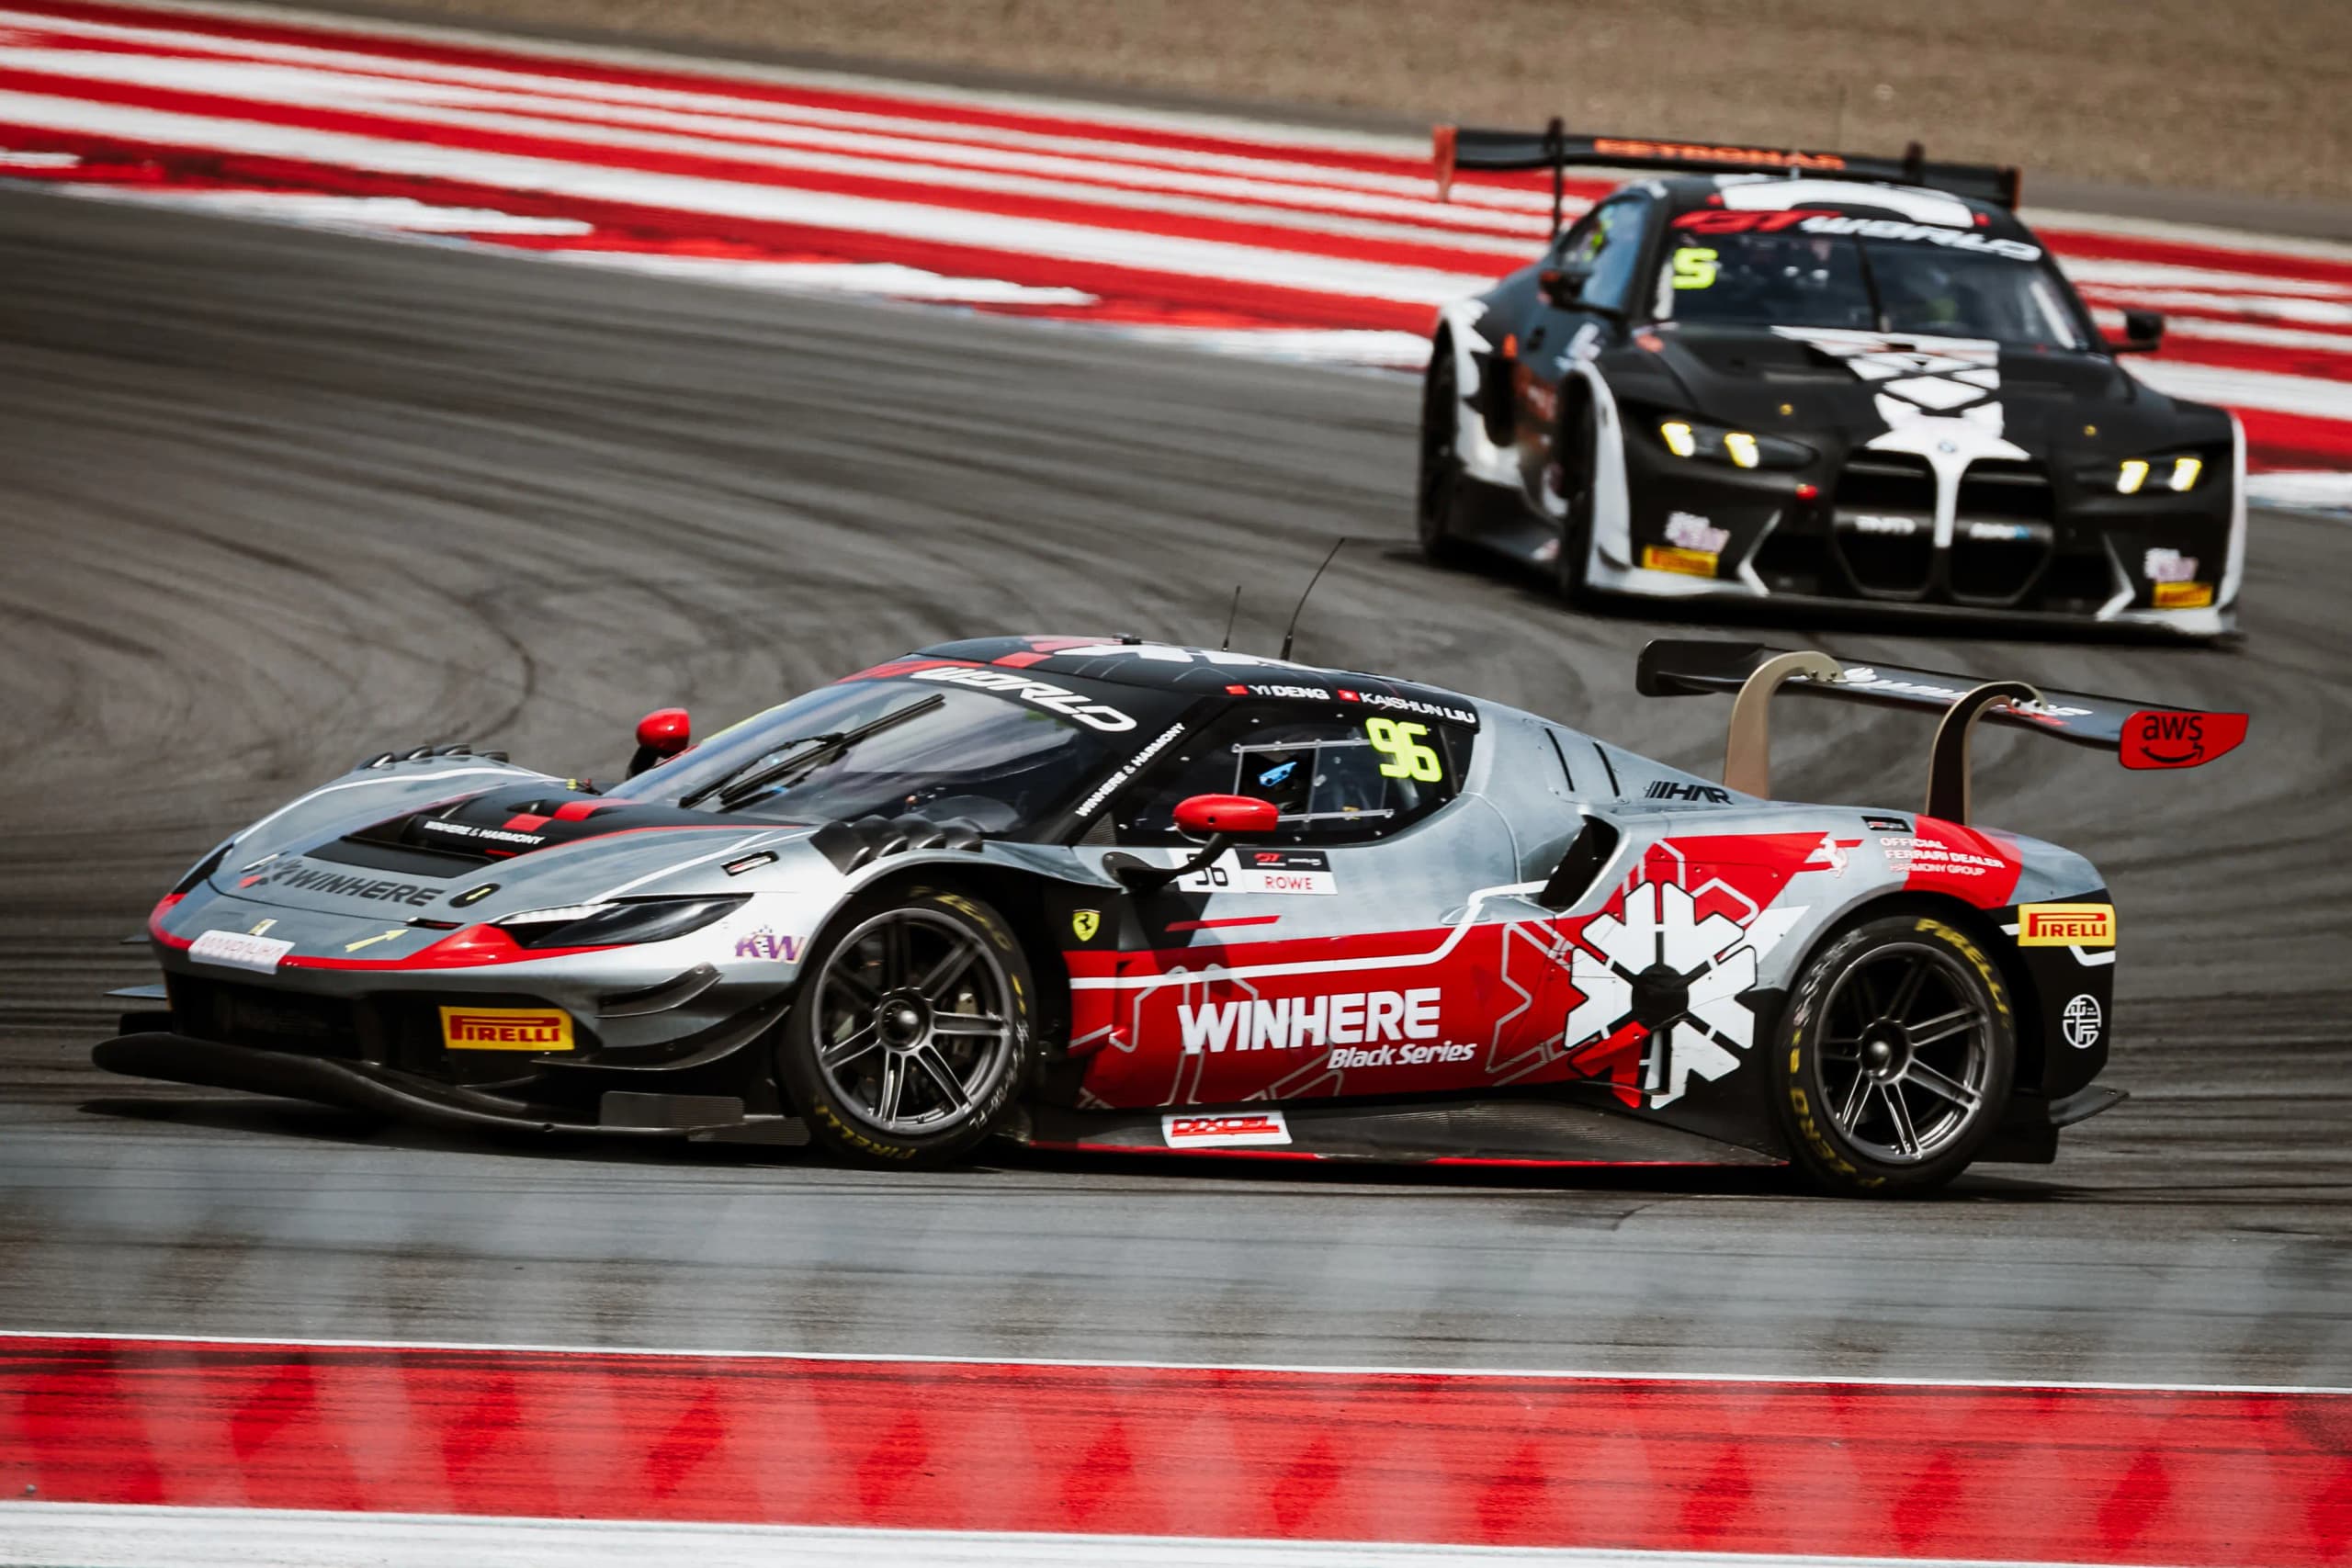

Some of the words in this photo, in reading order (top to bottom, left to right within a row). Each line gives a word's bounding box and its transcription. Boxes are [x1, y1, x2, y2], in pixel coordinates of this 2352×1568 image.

[1249, 684, 1272, 696] YI
[1270, 685, 1330, 700] DENG
[1360, 693, 1444, 717] KAISHUN
[1442, 706, 1476, 724] LIU
[2143, 715, 2203, 740] aws
[1365, 716, 1442, 783] 96
[1075, 771, 1128, 817] WINHERE
[1130, 723, 1185, 766] HARMONY
[479, 829, 546, 844] HARMONY
[1880, 837, 1948, 850] OFFICIAL
[1885, 850, 1949, 862] FERRARI
[1950, 852, 2006, 868] DEALER
[1947, 865, 1985, 875] GROUP
[283, 870, 447, 907] WINHERE
[1264, 875, 1314, 890] ROWE
[2028, 912, 2107, 937] PIRELLI
[449, 1014, 560, 1042] PIRELLI
[1177, 987, 1442, 1055] WINHERE
[1327, 1043, 1396, 1070] Black
[1396, 1041, 1477, 1066] Series
